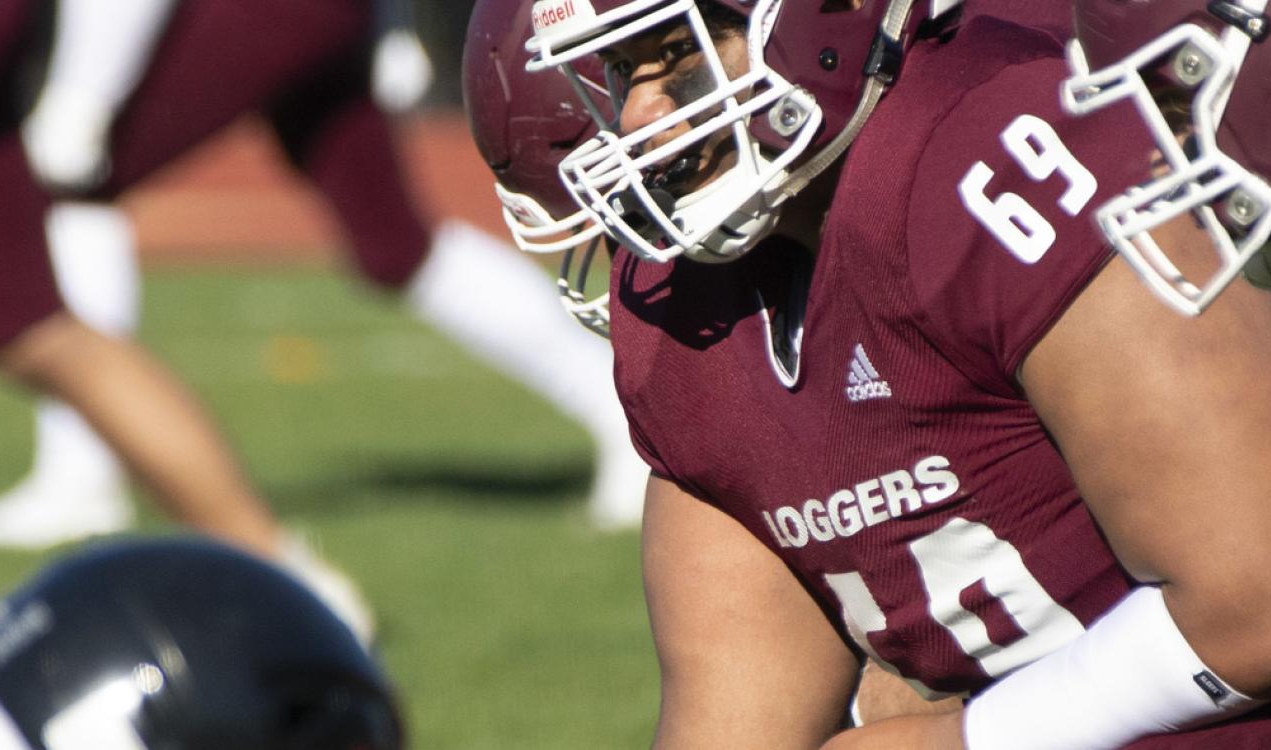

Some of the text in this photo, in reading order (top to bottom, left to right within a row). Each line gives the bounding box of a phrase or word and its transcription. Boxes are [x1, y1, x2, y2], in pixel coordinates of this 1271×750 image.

[957, 114, 1098, 264] 69
[847, 380, 892, 401] adidas
[763, 455, 960, 549] LOGGERS
